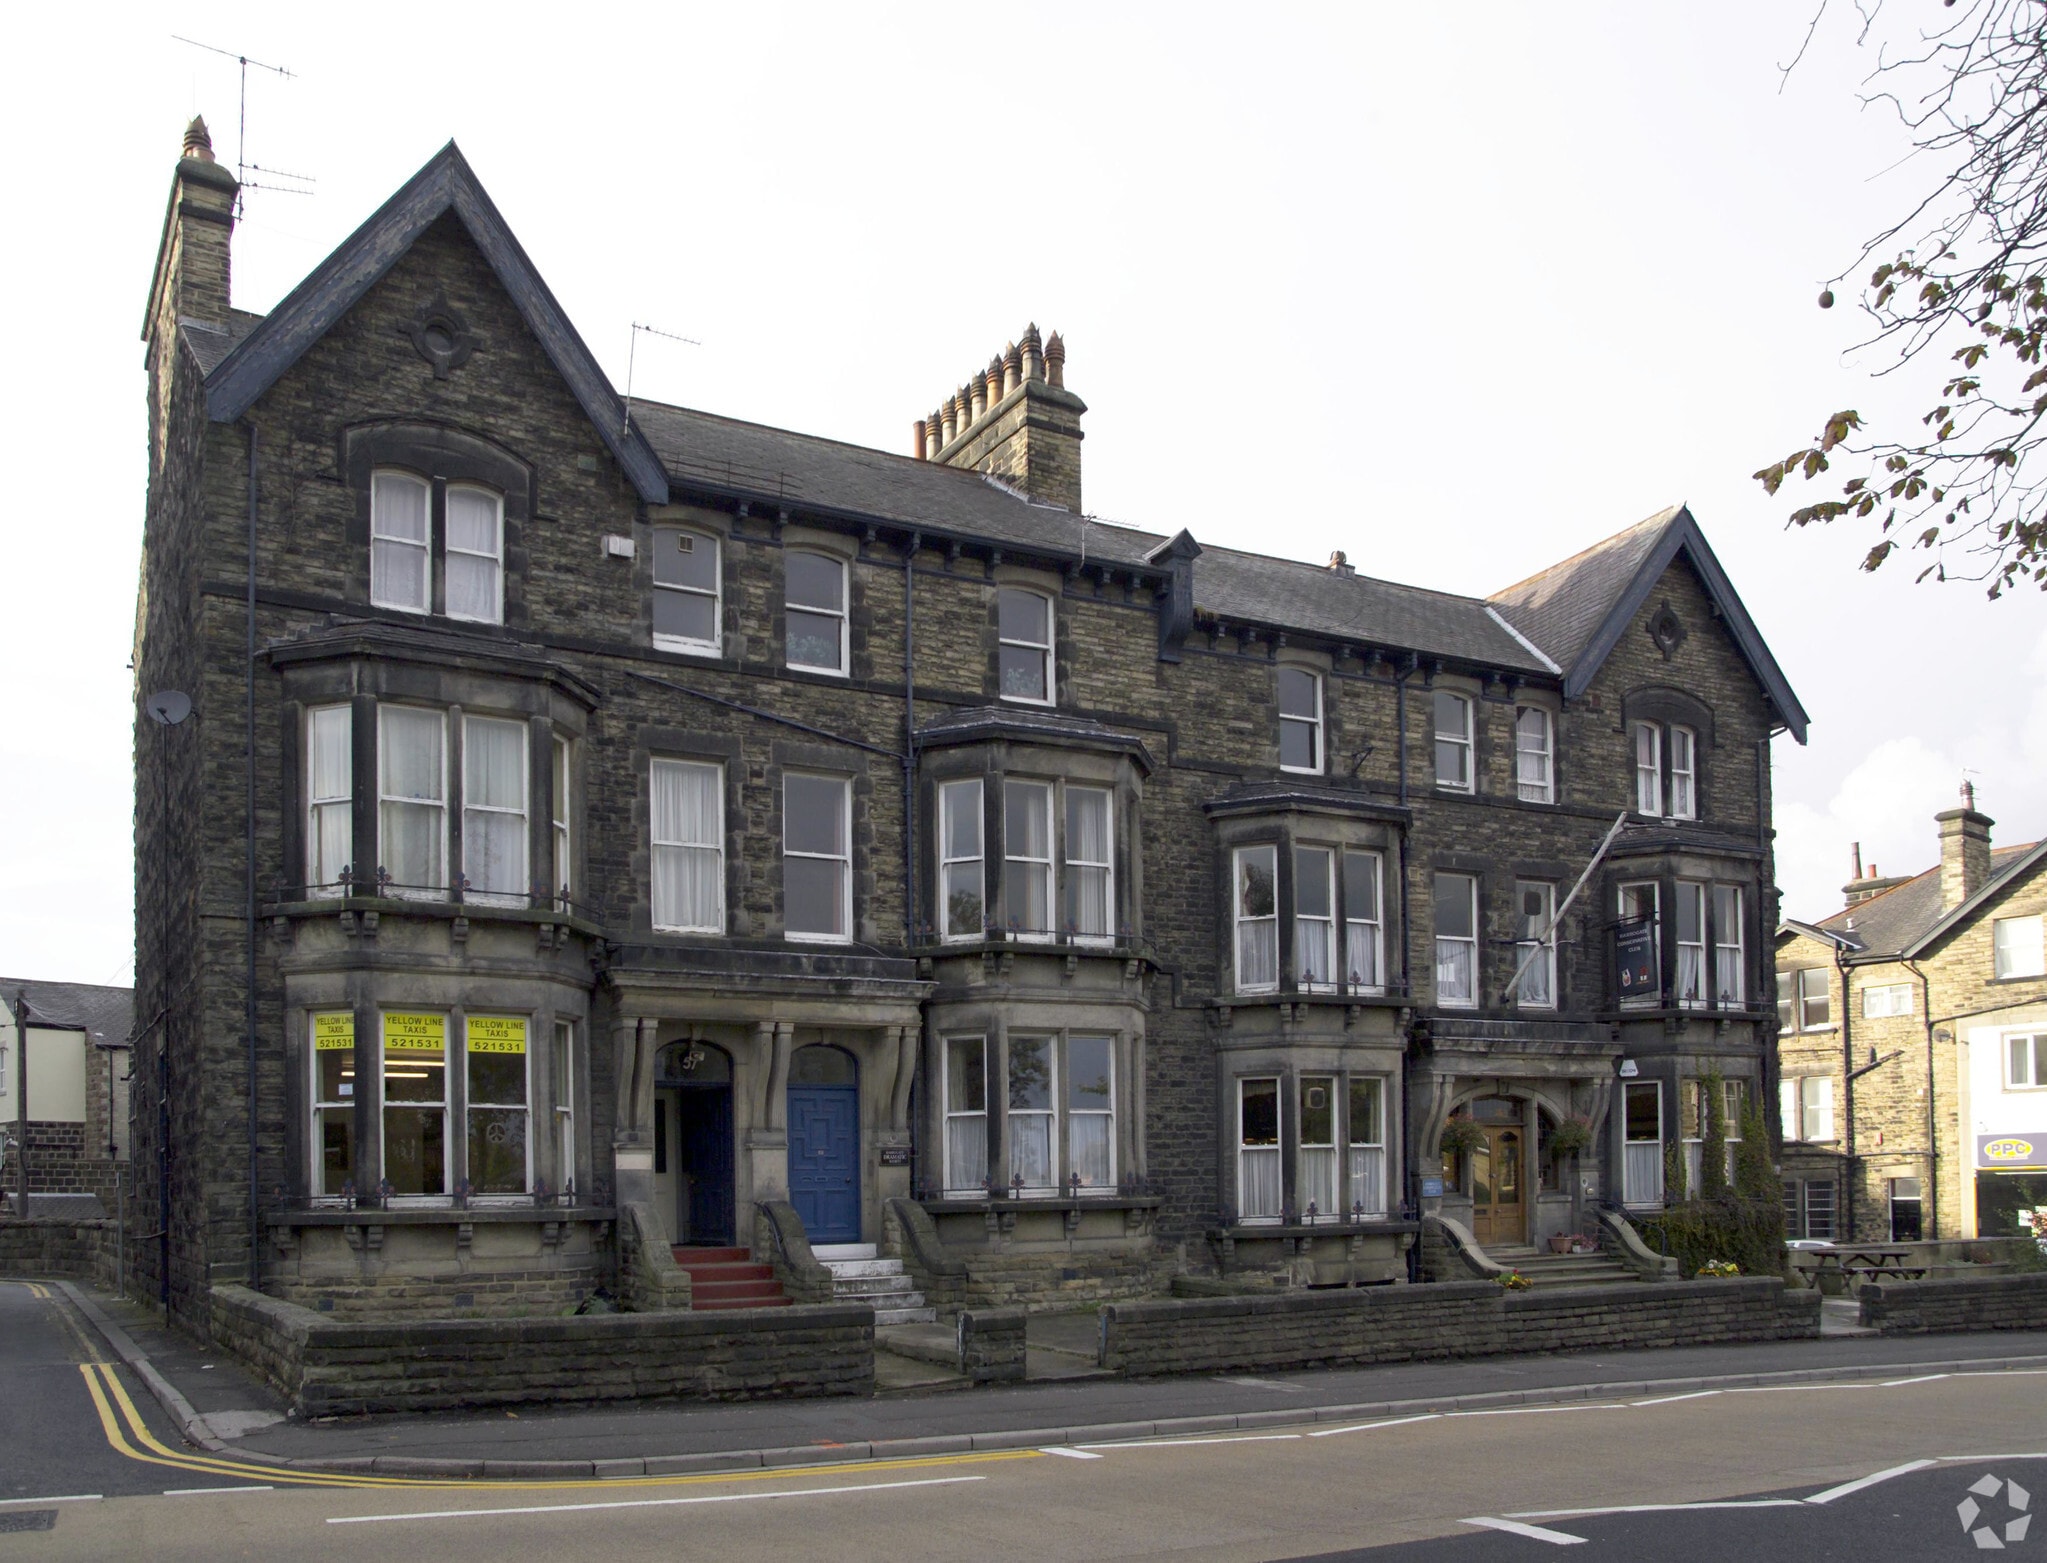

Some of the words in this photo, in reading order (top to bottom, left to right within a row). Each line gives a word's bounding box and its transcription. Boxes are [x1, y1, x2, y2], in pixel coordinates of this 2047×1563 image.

[1619, 929, 1648, 938] HARROGATE
[1617, 936, 1650, 947] CONSERVATIVE
[316, 1017, 340, 1025] YELLOW
[386, 1016, 422, 1024] YELLOW
[424, 1018, 444, 1026] LINE
[470, 1020, 503, 1029] YELLOW
[506, 1021, 524, 1030] LINE
[403, 1025, 427, 1034] TAXIS
[486, 1029, 509, 1037] TAXIS
[320, 1039, 352, 1047] 521531
[391, 1038, 439, 1048] 521531
[474, 1041, 520, 1051] 521531
[1991, 1143, 2026, 1154] PPC
